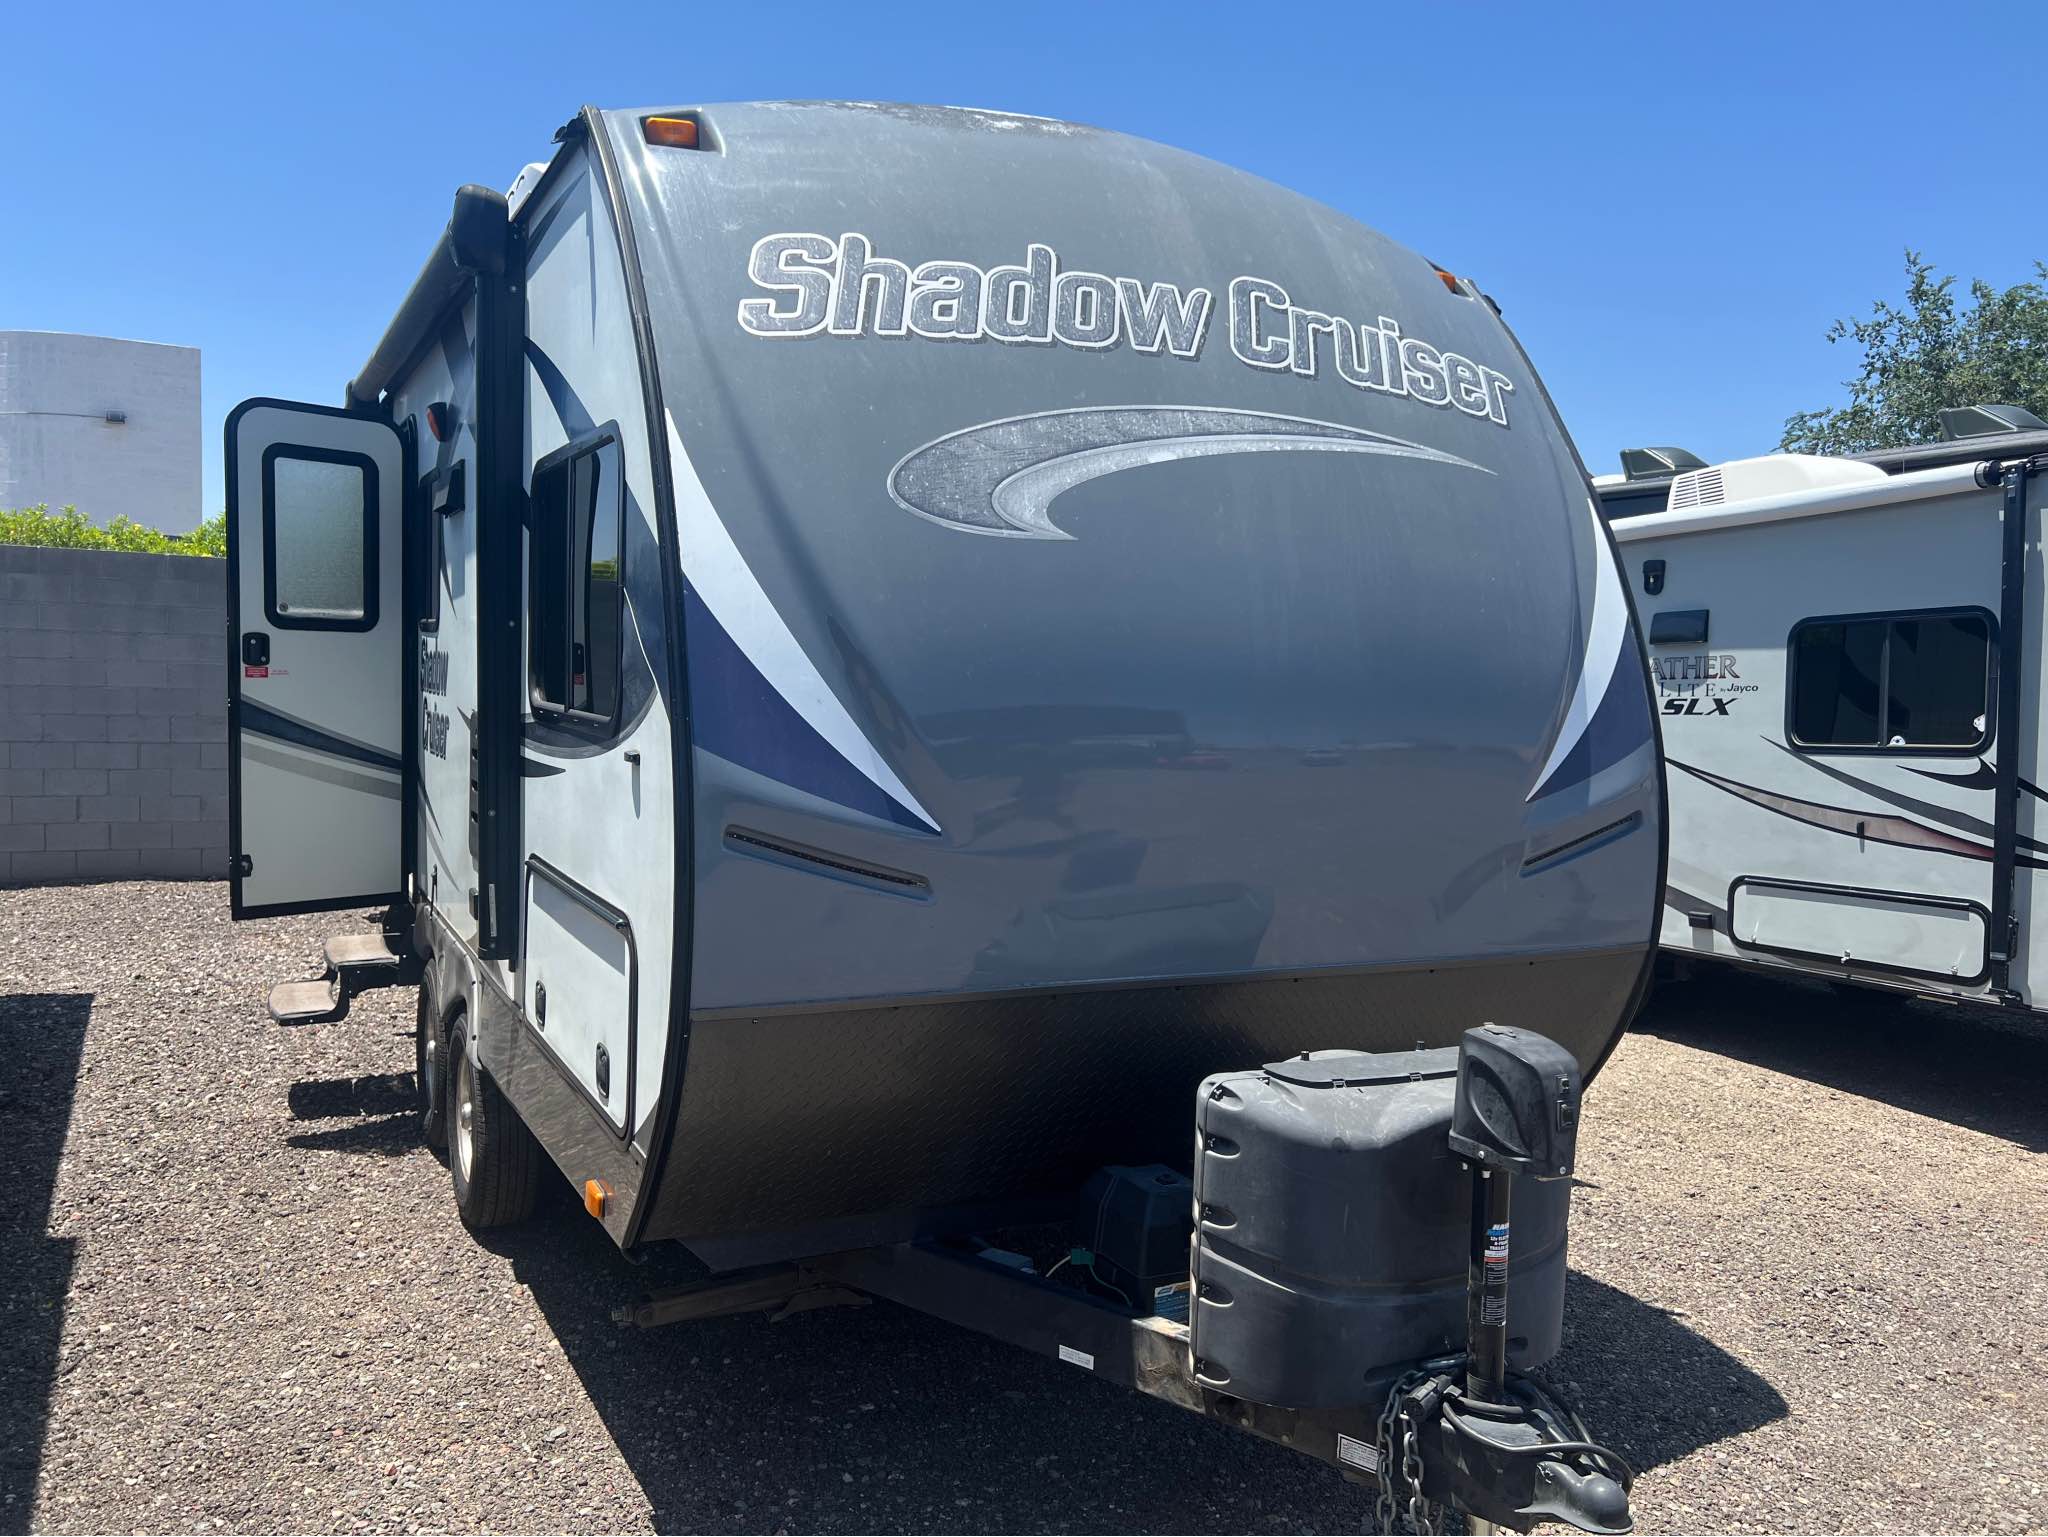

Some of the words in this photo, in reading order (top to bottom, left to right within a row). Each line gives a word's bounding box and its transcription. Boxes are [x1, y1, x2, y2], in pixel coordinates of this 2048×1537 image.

[737, 232, 1211, 360] Shadow
[1229, 275, 1514, 428] Cruiser
[420, 636, 449, 696] Shadow
[1660, 682, 1716, 697] LITE
[1727, 683, 1760, 694] Jayco
[423, 696, 450, 761] Cruiser
[1660, 698, 1739, 716] SLX
